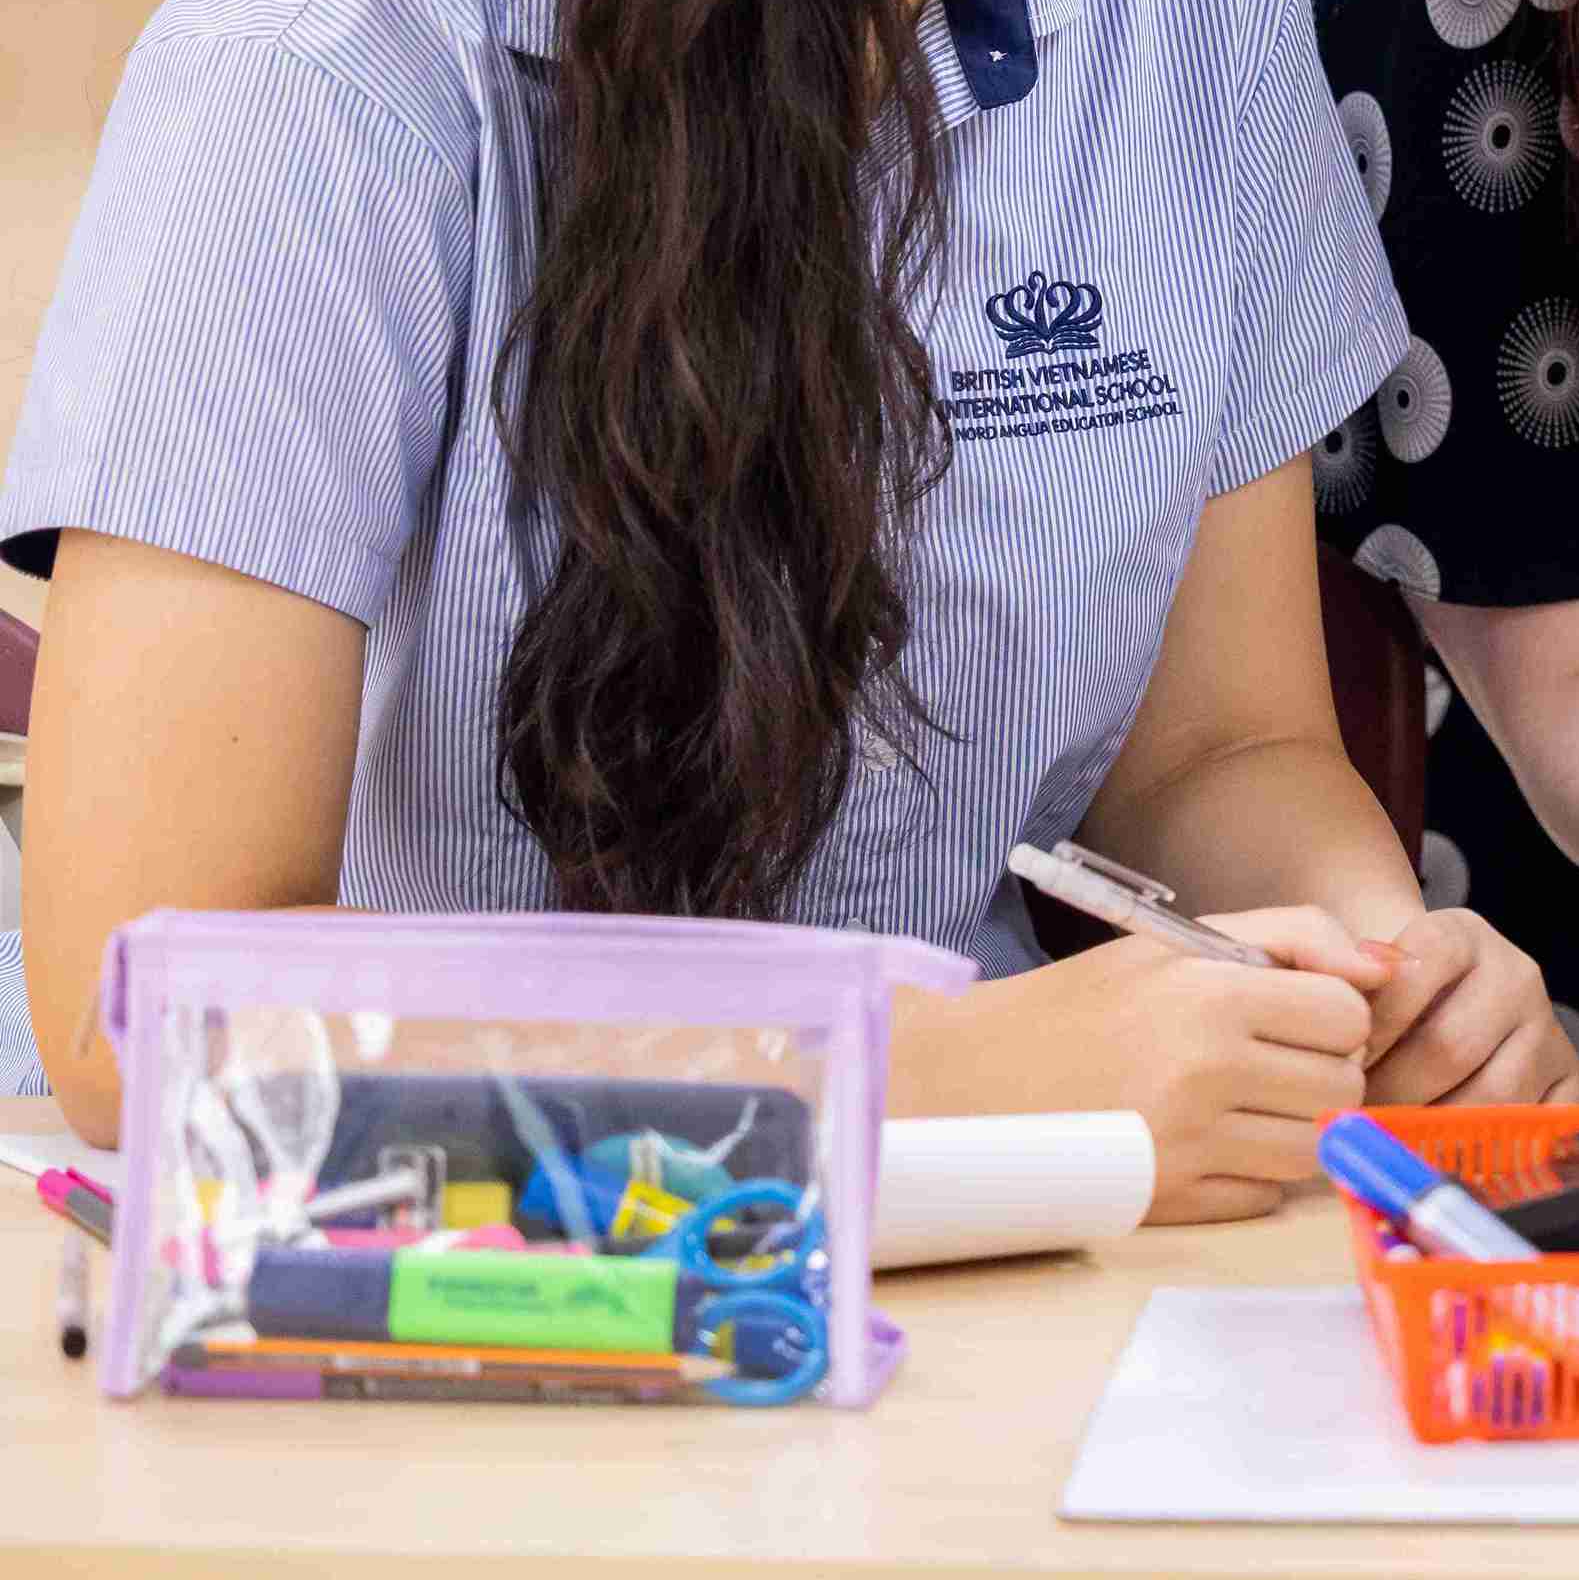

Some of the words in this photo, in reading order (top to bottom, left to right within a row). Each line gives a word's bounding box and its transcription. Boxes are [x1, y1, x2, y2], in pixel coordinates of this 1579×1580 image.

[952, 368, 1025, 392] BRITISH
[1026, 349, 1151, 386] VIETNAMESE
[1094, 374, 1177, 406] SCHOOL
[955, 426, 997, 441] NORD
[1051, 411, 1124, 434] EDUCATION
[1125, 401, 1184, 423] SCHOOL
